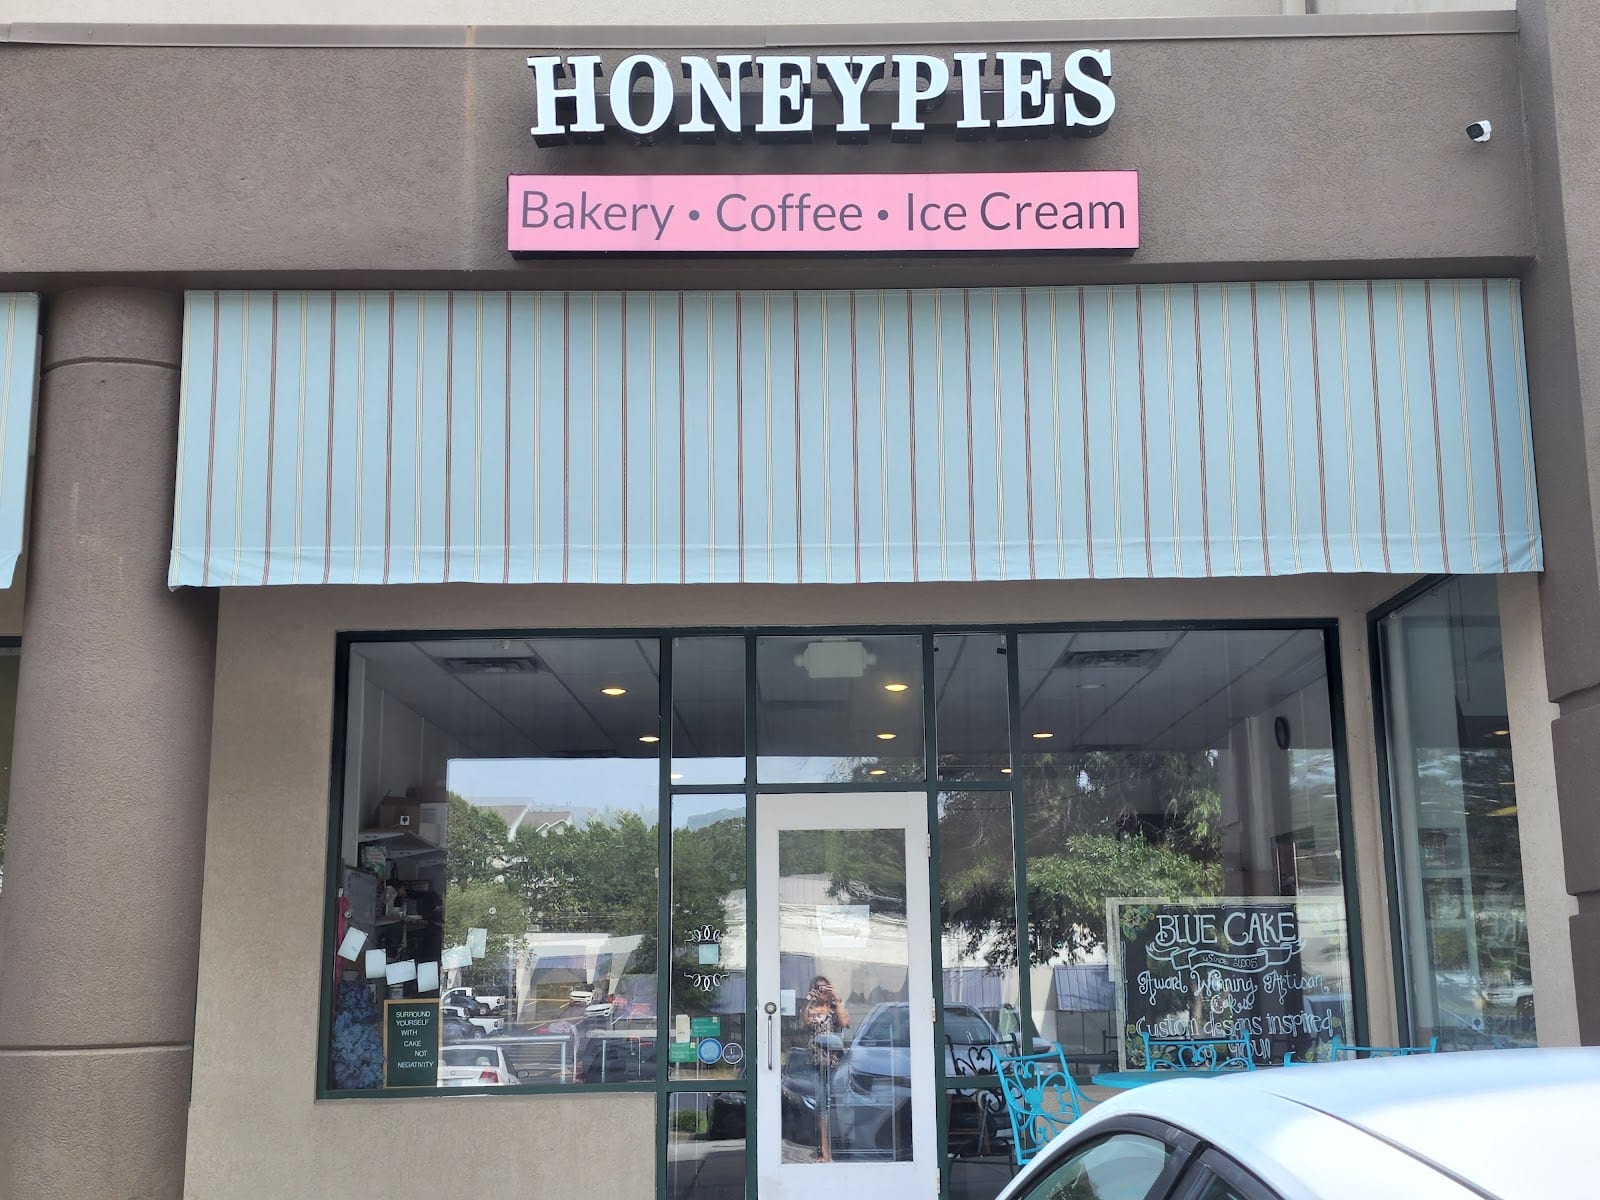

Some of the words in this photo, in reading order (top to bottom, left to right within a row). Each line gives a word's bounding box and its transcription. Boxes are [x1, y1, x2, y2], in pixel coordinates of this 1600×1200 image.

[526, 48, 1117, 137] HONEYPIES
[521, 190, 675, 239] Bakery
[715, 192, 864, 232] Coffee
[906, 192, 968, 232] Ice
[981, 190, 1126, 232] Cream
[1154, 913, 1218, 947] BLUE
[1223, 911, 1297, 947] CAKE
[1233, 957, 1258, 969] 2005
[1137, 969, 1189, 1006] Award
[1190, 968, 1259, 1004] Winning
[1262, 969, 1331, 1005] Artisan
[395, 1010, 431, 1018] SURROUND
[396, 1019, 430, 1027] YOURSELF
[1135, 1015, 1200, 1038] Custom
[1203, 1011, 1264, 1040] designs
[1265, 1009, 1335, 1038] inspired
[397, 1061, 434, 1069] NEGATIVITY
